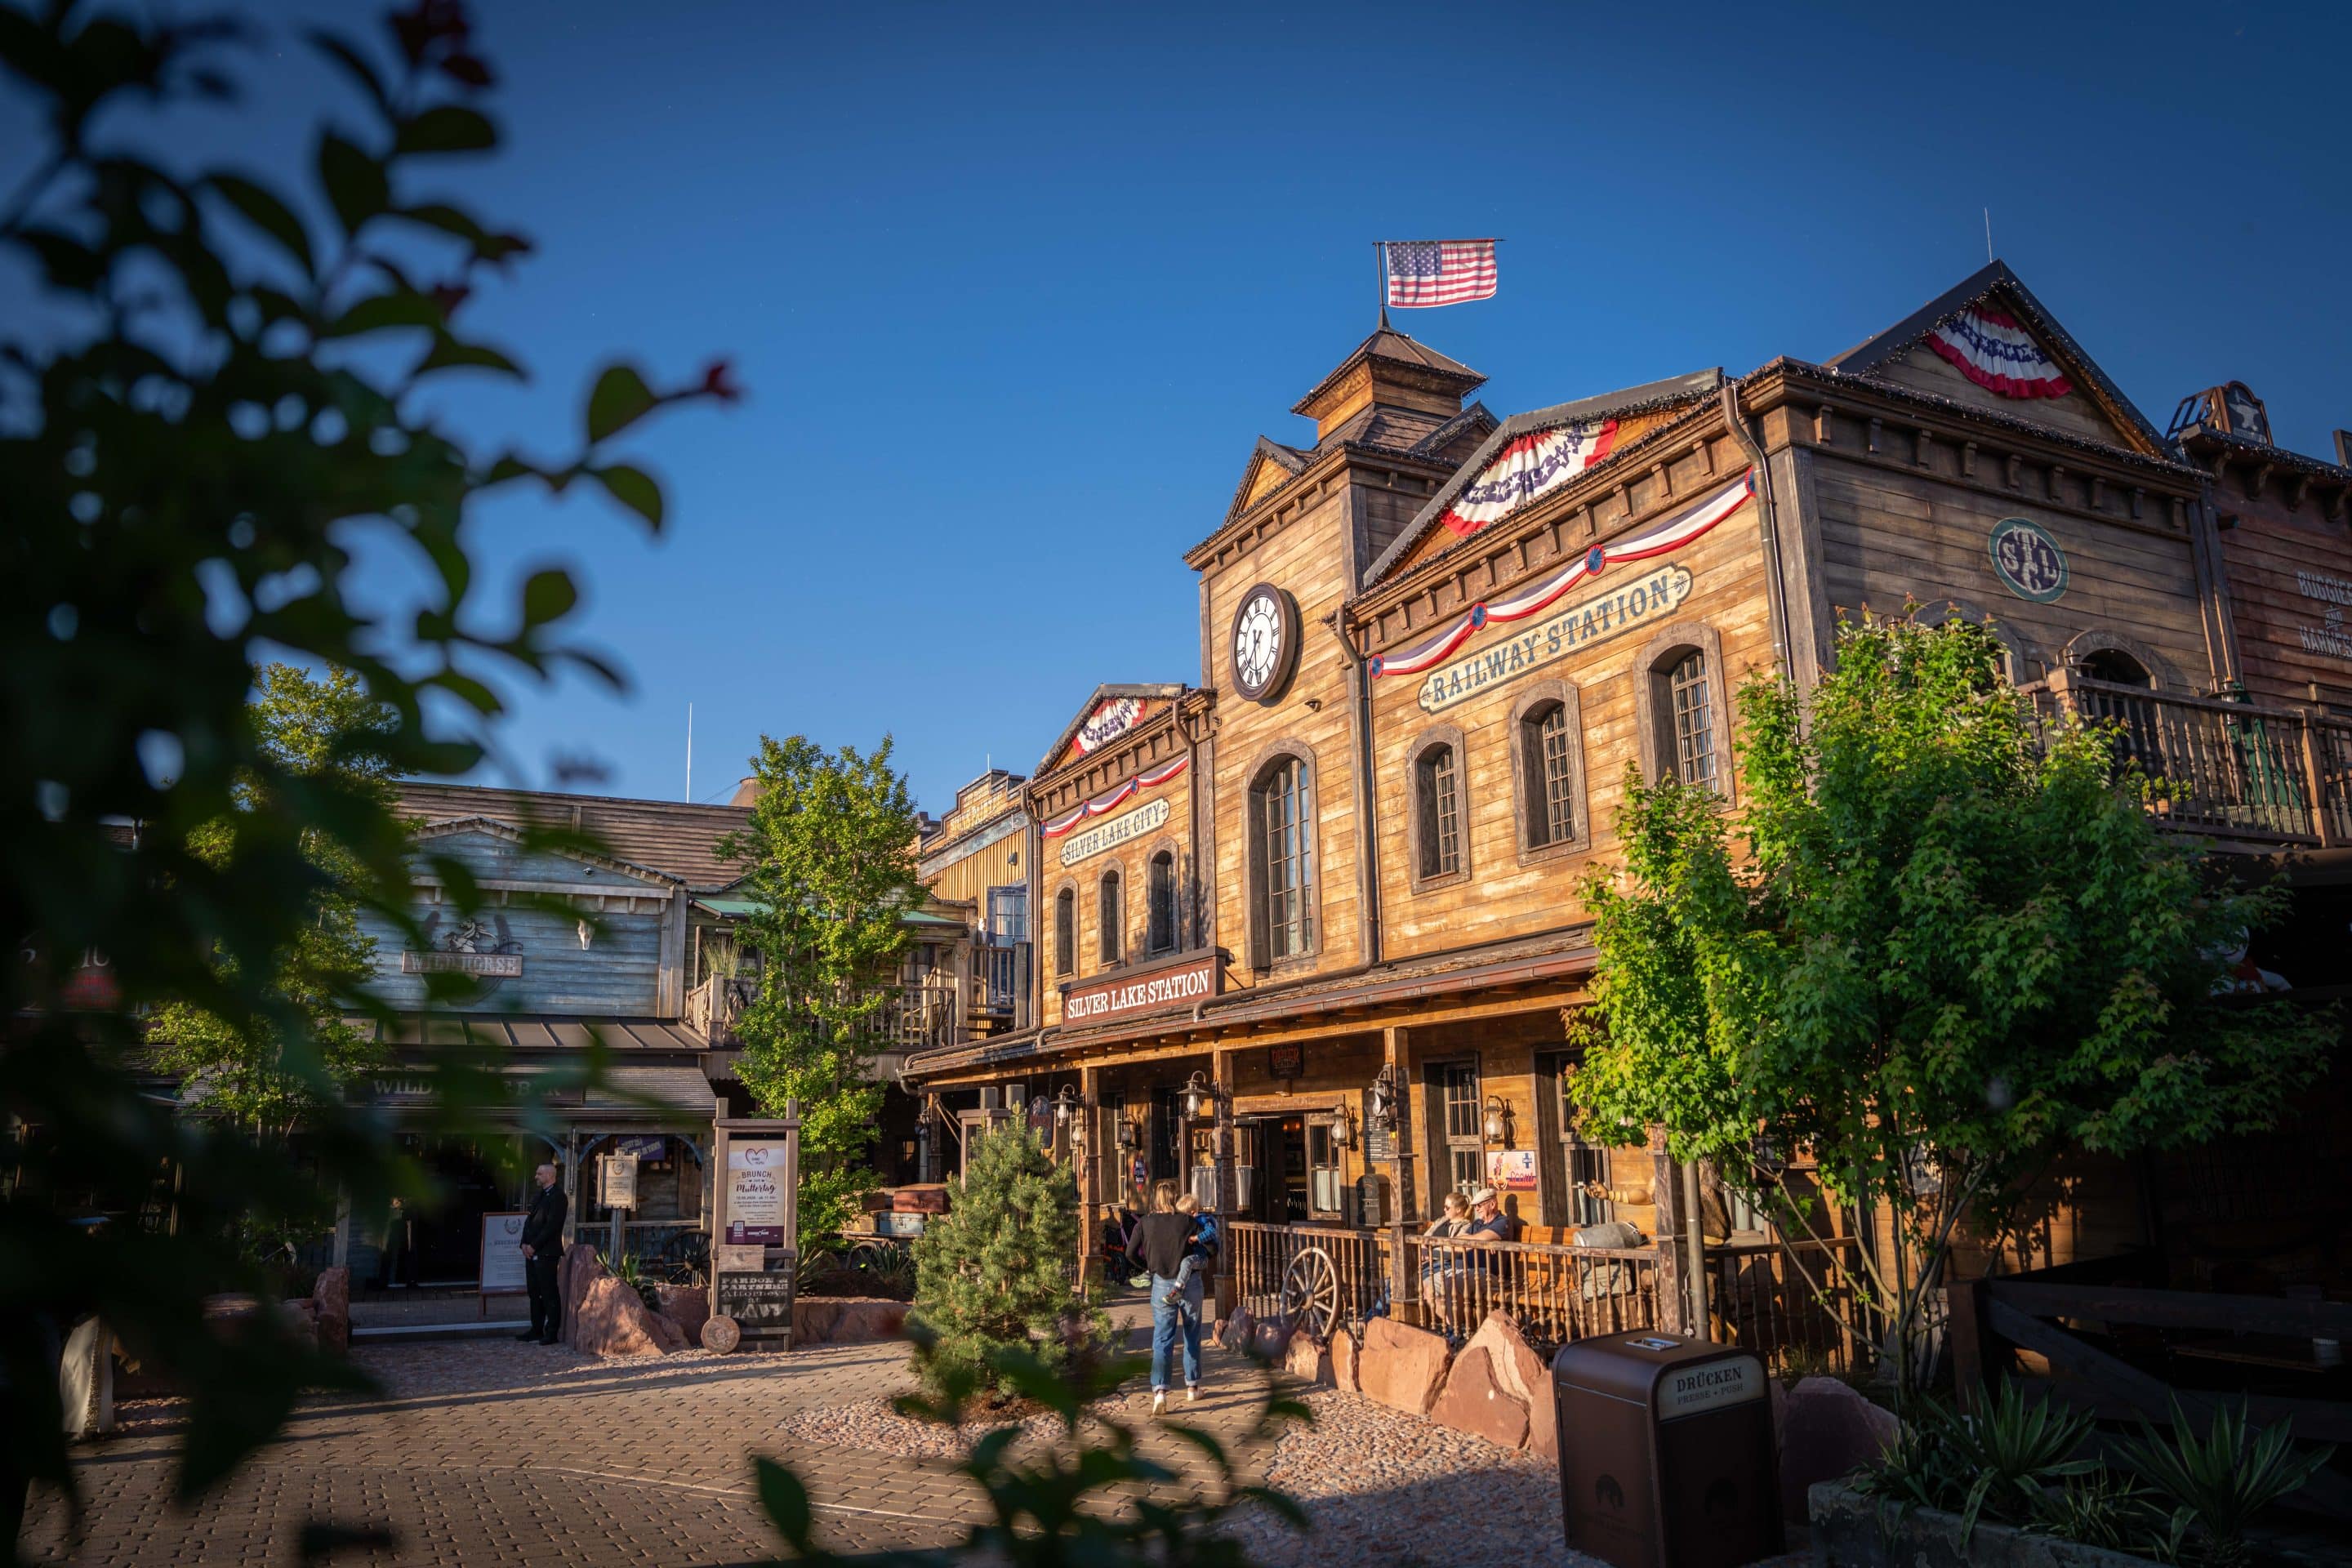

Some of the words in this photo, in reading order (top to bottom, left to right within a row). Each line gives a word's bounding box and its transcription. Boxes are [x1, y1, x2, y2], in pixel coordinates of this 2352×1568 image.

[1432, 635, 1544, 703] RAILWAY
[1548, 575, 1668, 653] STATION
[2300, 626, 2352, 657] HARNES
[1065, 833, 1099, 861] SILVER
[1102, 818, 1130, 847] LAKE
[1134, 803, 1160, 833] CITY
[461, 955, 517, 974] HORSE
[1068, 991, 1109, 1019] SILVER
[1111, 984, 1147, 1011] LAKE
[1147, 969, 1209, 1004] STATION
[373, 1080, 433, 1095] WILD
[742, 1170, 772, 1178] BRUNCH
[736, 1183, 775, 1194] Muttertag
[722, 1303, 786, 1318] LAW
[1677, 1366, 1742, 1392] DRÜCKEN
[1677, 1390, 1711, 1405] PRESSE
[1721, 1383, 1744, 1396] PUSH
